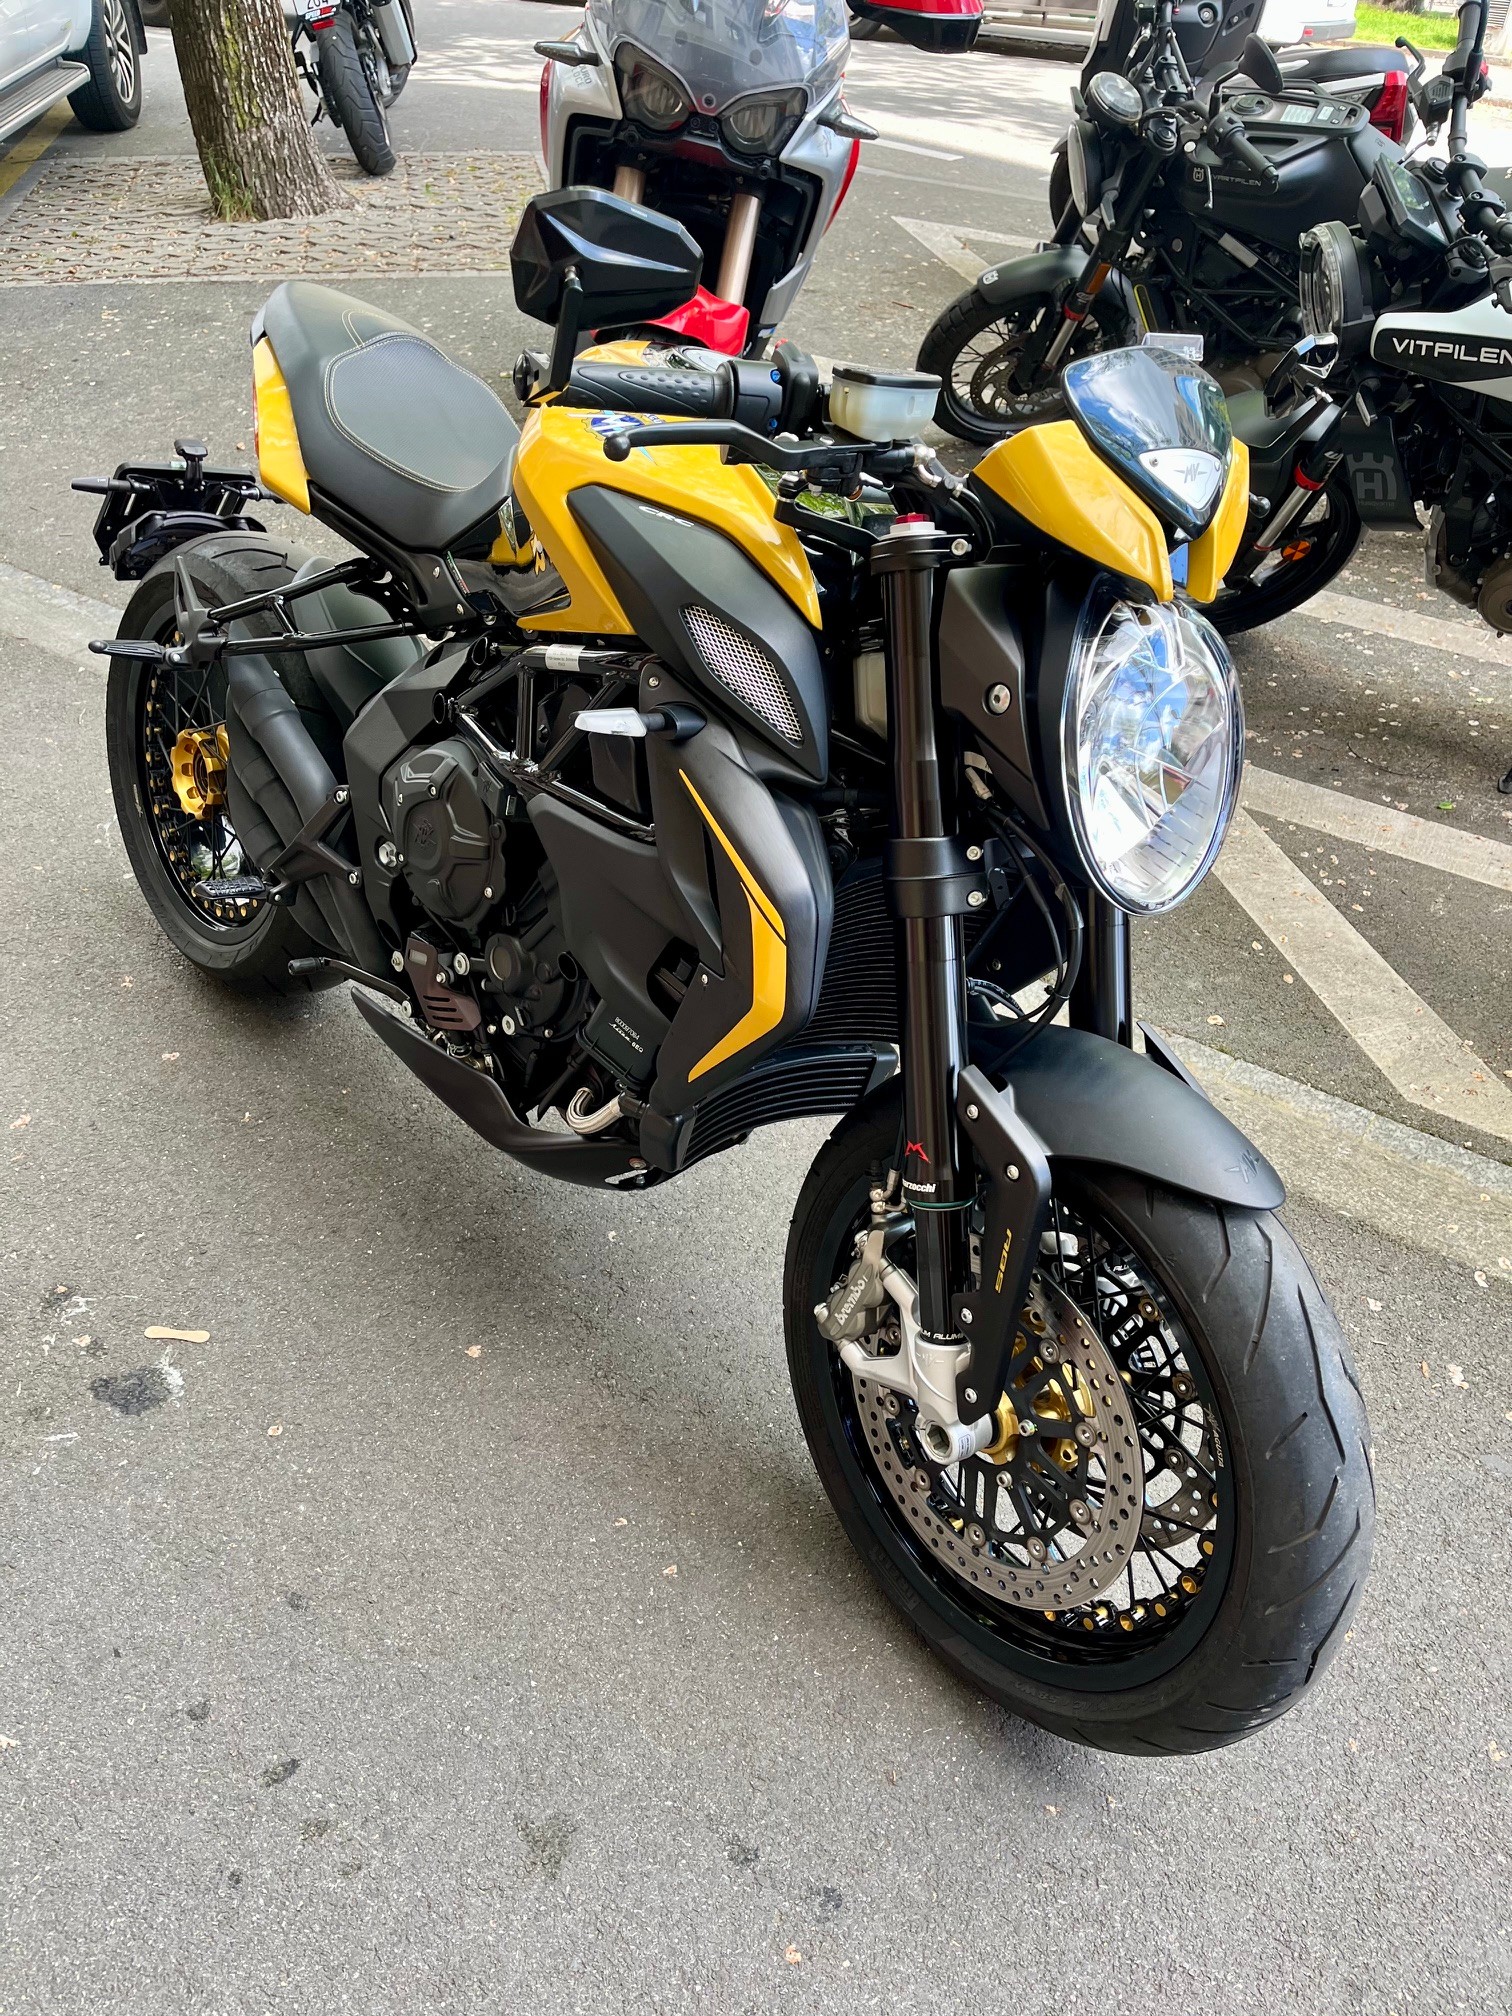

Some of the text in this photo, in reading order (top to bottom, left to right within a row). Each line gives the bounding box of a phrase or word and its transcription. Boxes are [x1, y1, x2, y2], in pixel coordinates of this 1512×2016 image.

[638, 505, 695, 528] CRC
[834, 1279, 866, 1326] brembo
[1213, 1429, 1225, 1468] AGUSTA
